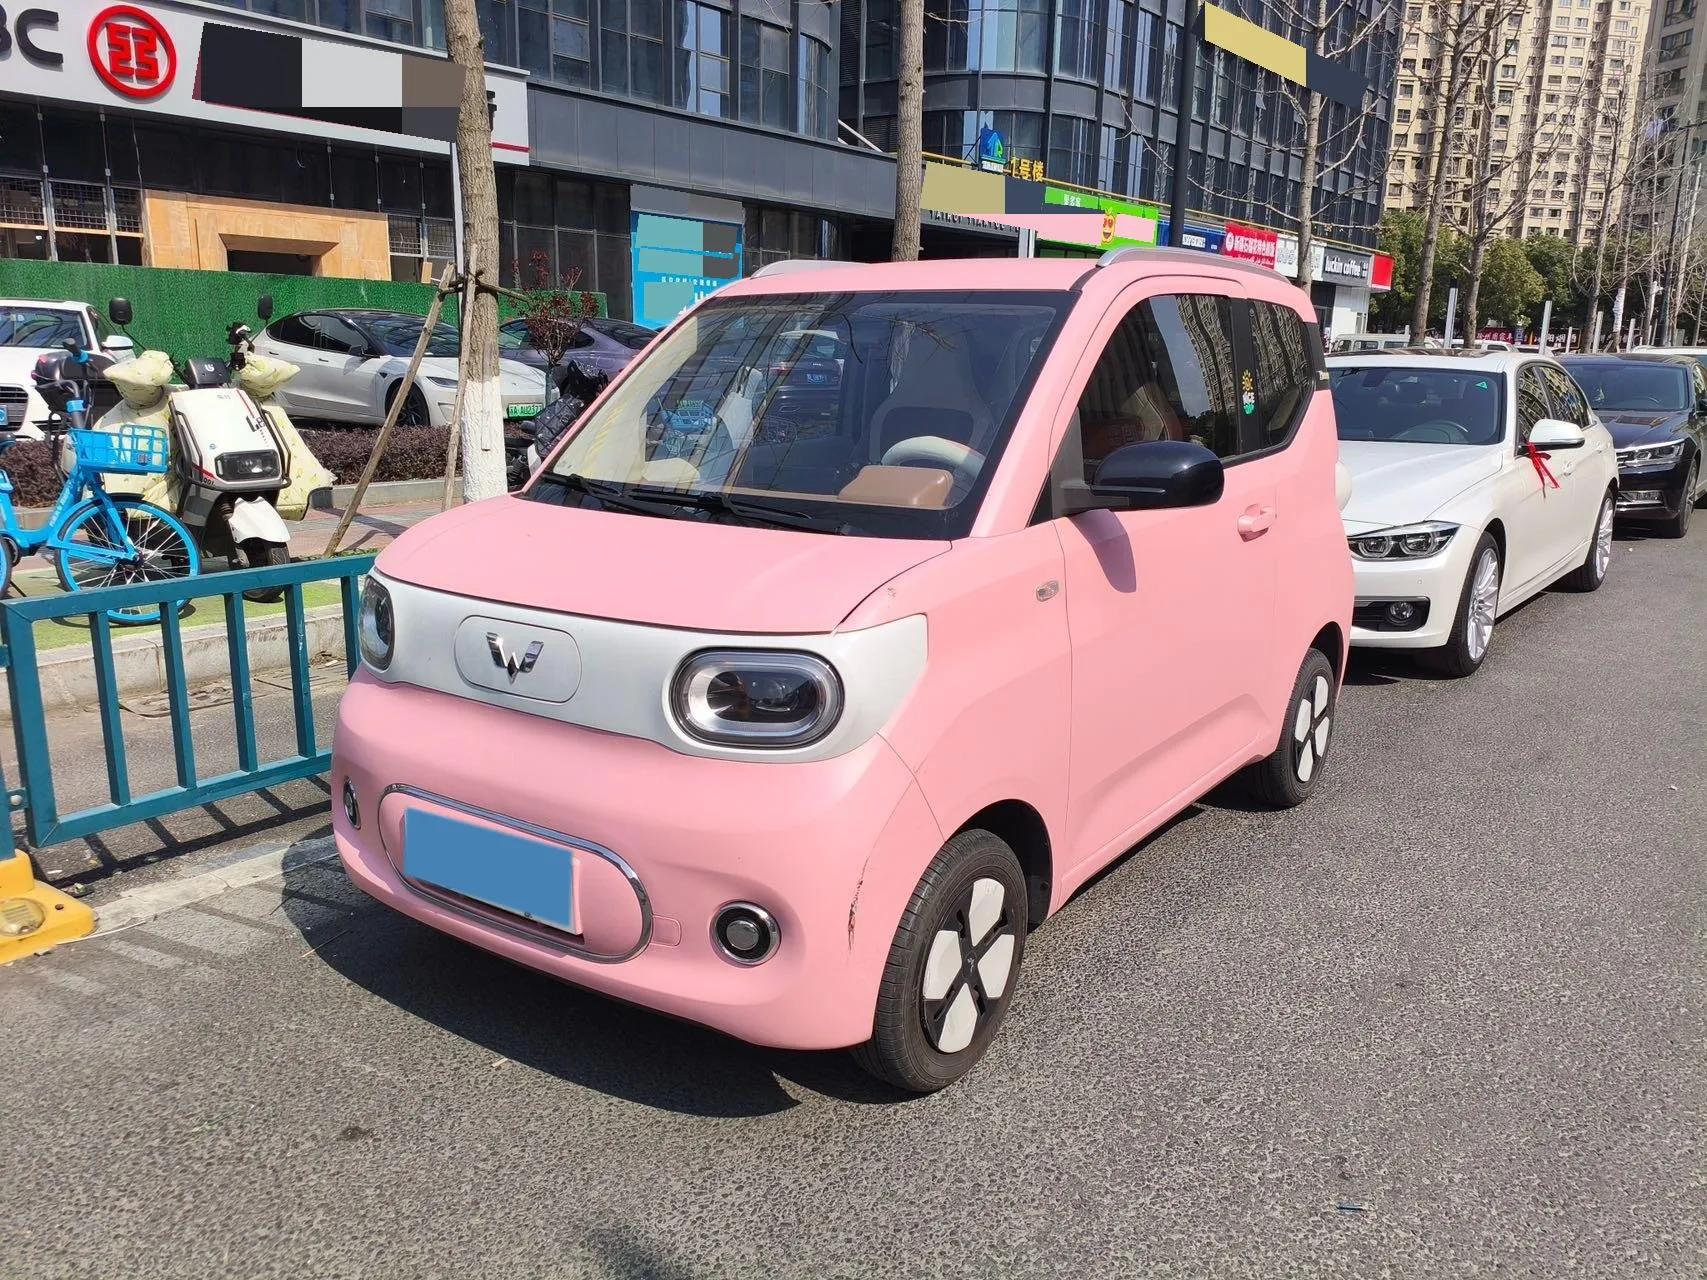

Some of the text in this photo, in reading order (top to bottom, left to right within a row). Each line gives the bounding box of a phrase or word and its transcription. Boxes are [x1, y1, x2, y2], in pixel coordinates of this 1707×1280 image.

[0, 3, 63, 64] C
[1011, 157, 1044, 182] 1号楼
[1325, 255, 1343, 273] luckin
[1343, 259, 1361, 277] coffee
